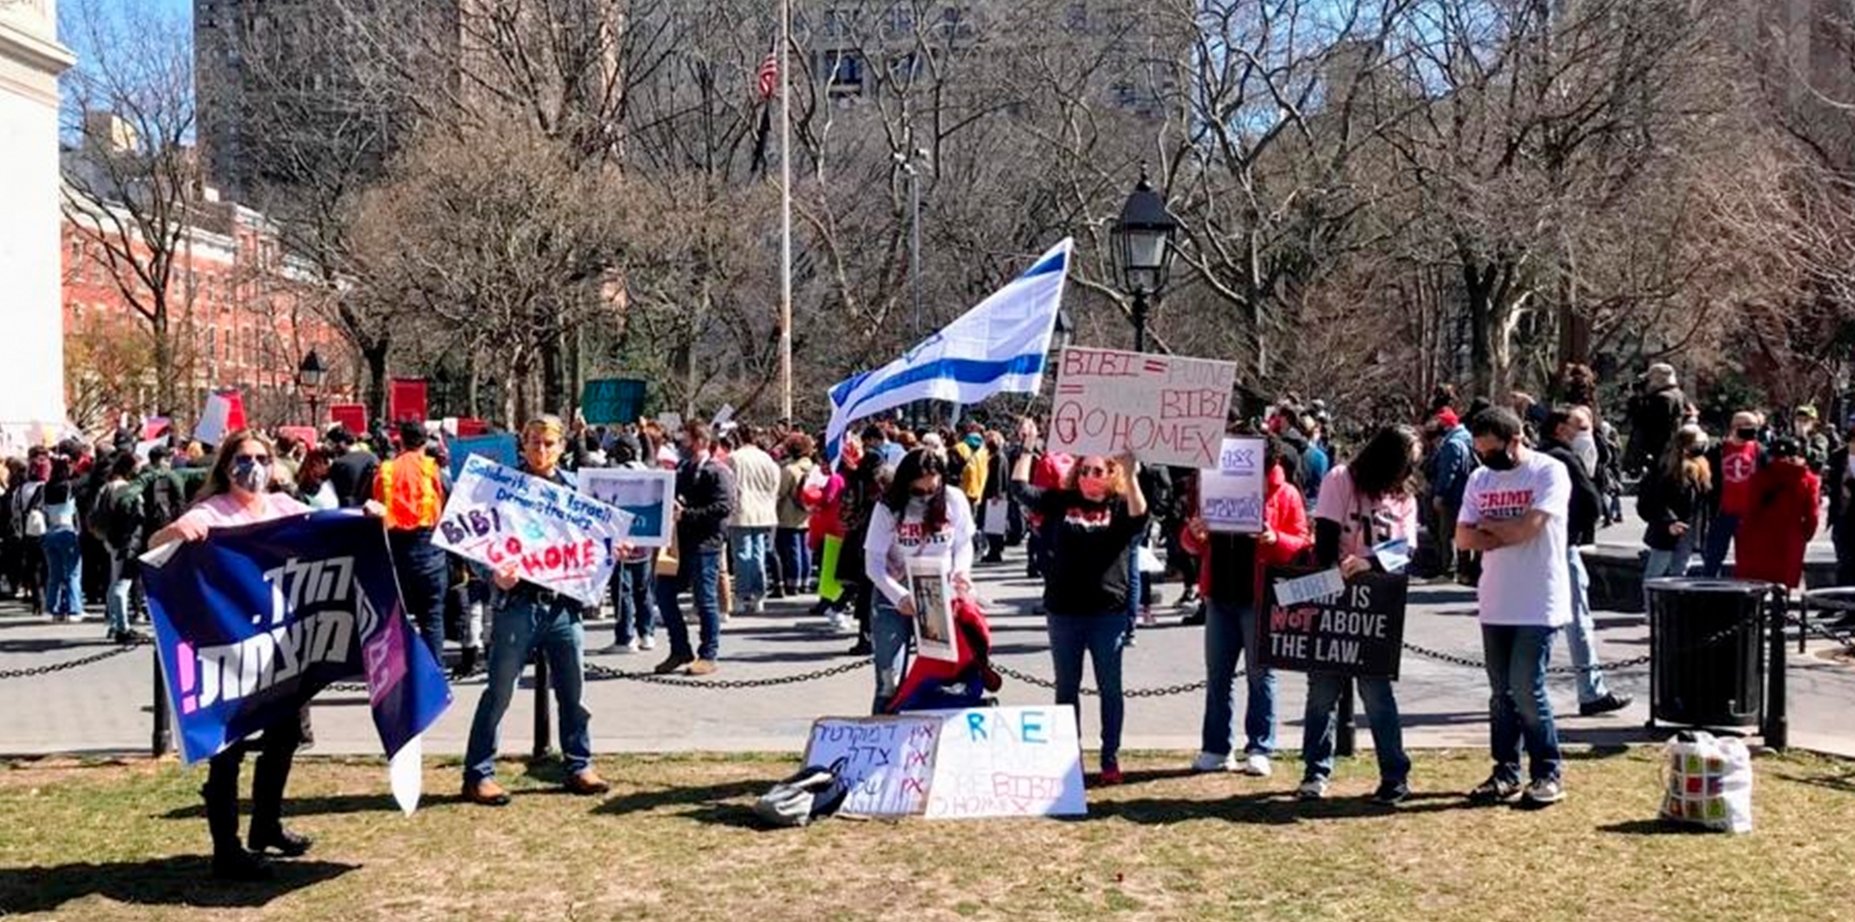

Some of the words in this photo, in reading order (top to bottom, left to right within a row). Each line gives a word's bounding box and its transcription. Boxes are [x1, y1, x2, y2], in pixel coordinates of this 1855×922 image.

[1063, 350, 1140, 377] BIBI
[1160, 389, 1228, 420] BIBI
[440, 507, 501, 545] BIBI
[487, 537, 522, 563] GO
[1351, 584, 1371, 609] IS
[1270, 604, 1319, 632] NOT
[1319, 609, 1388, 638] ABOVE
[1270, 633, 1308, 659] THE
[1315, 637, 1364, 665] LAW.
